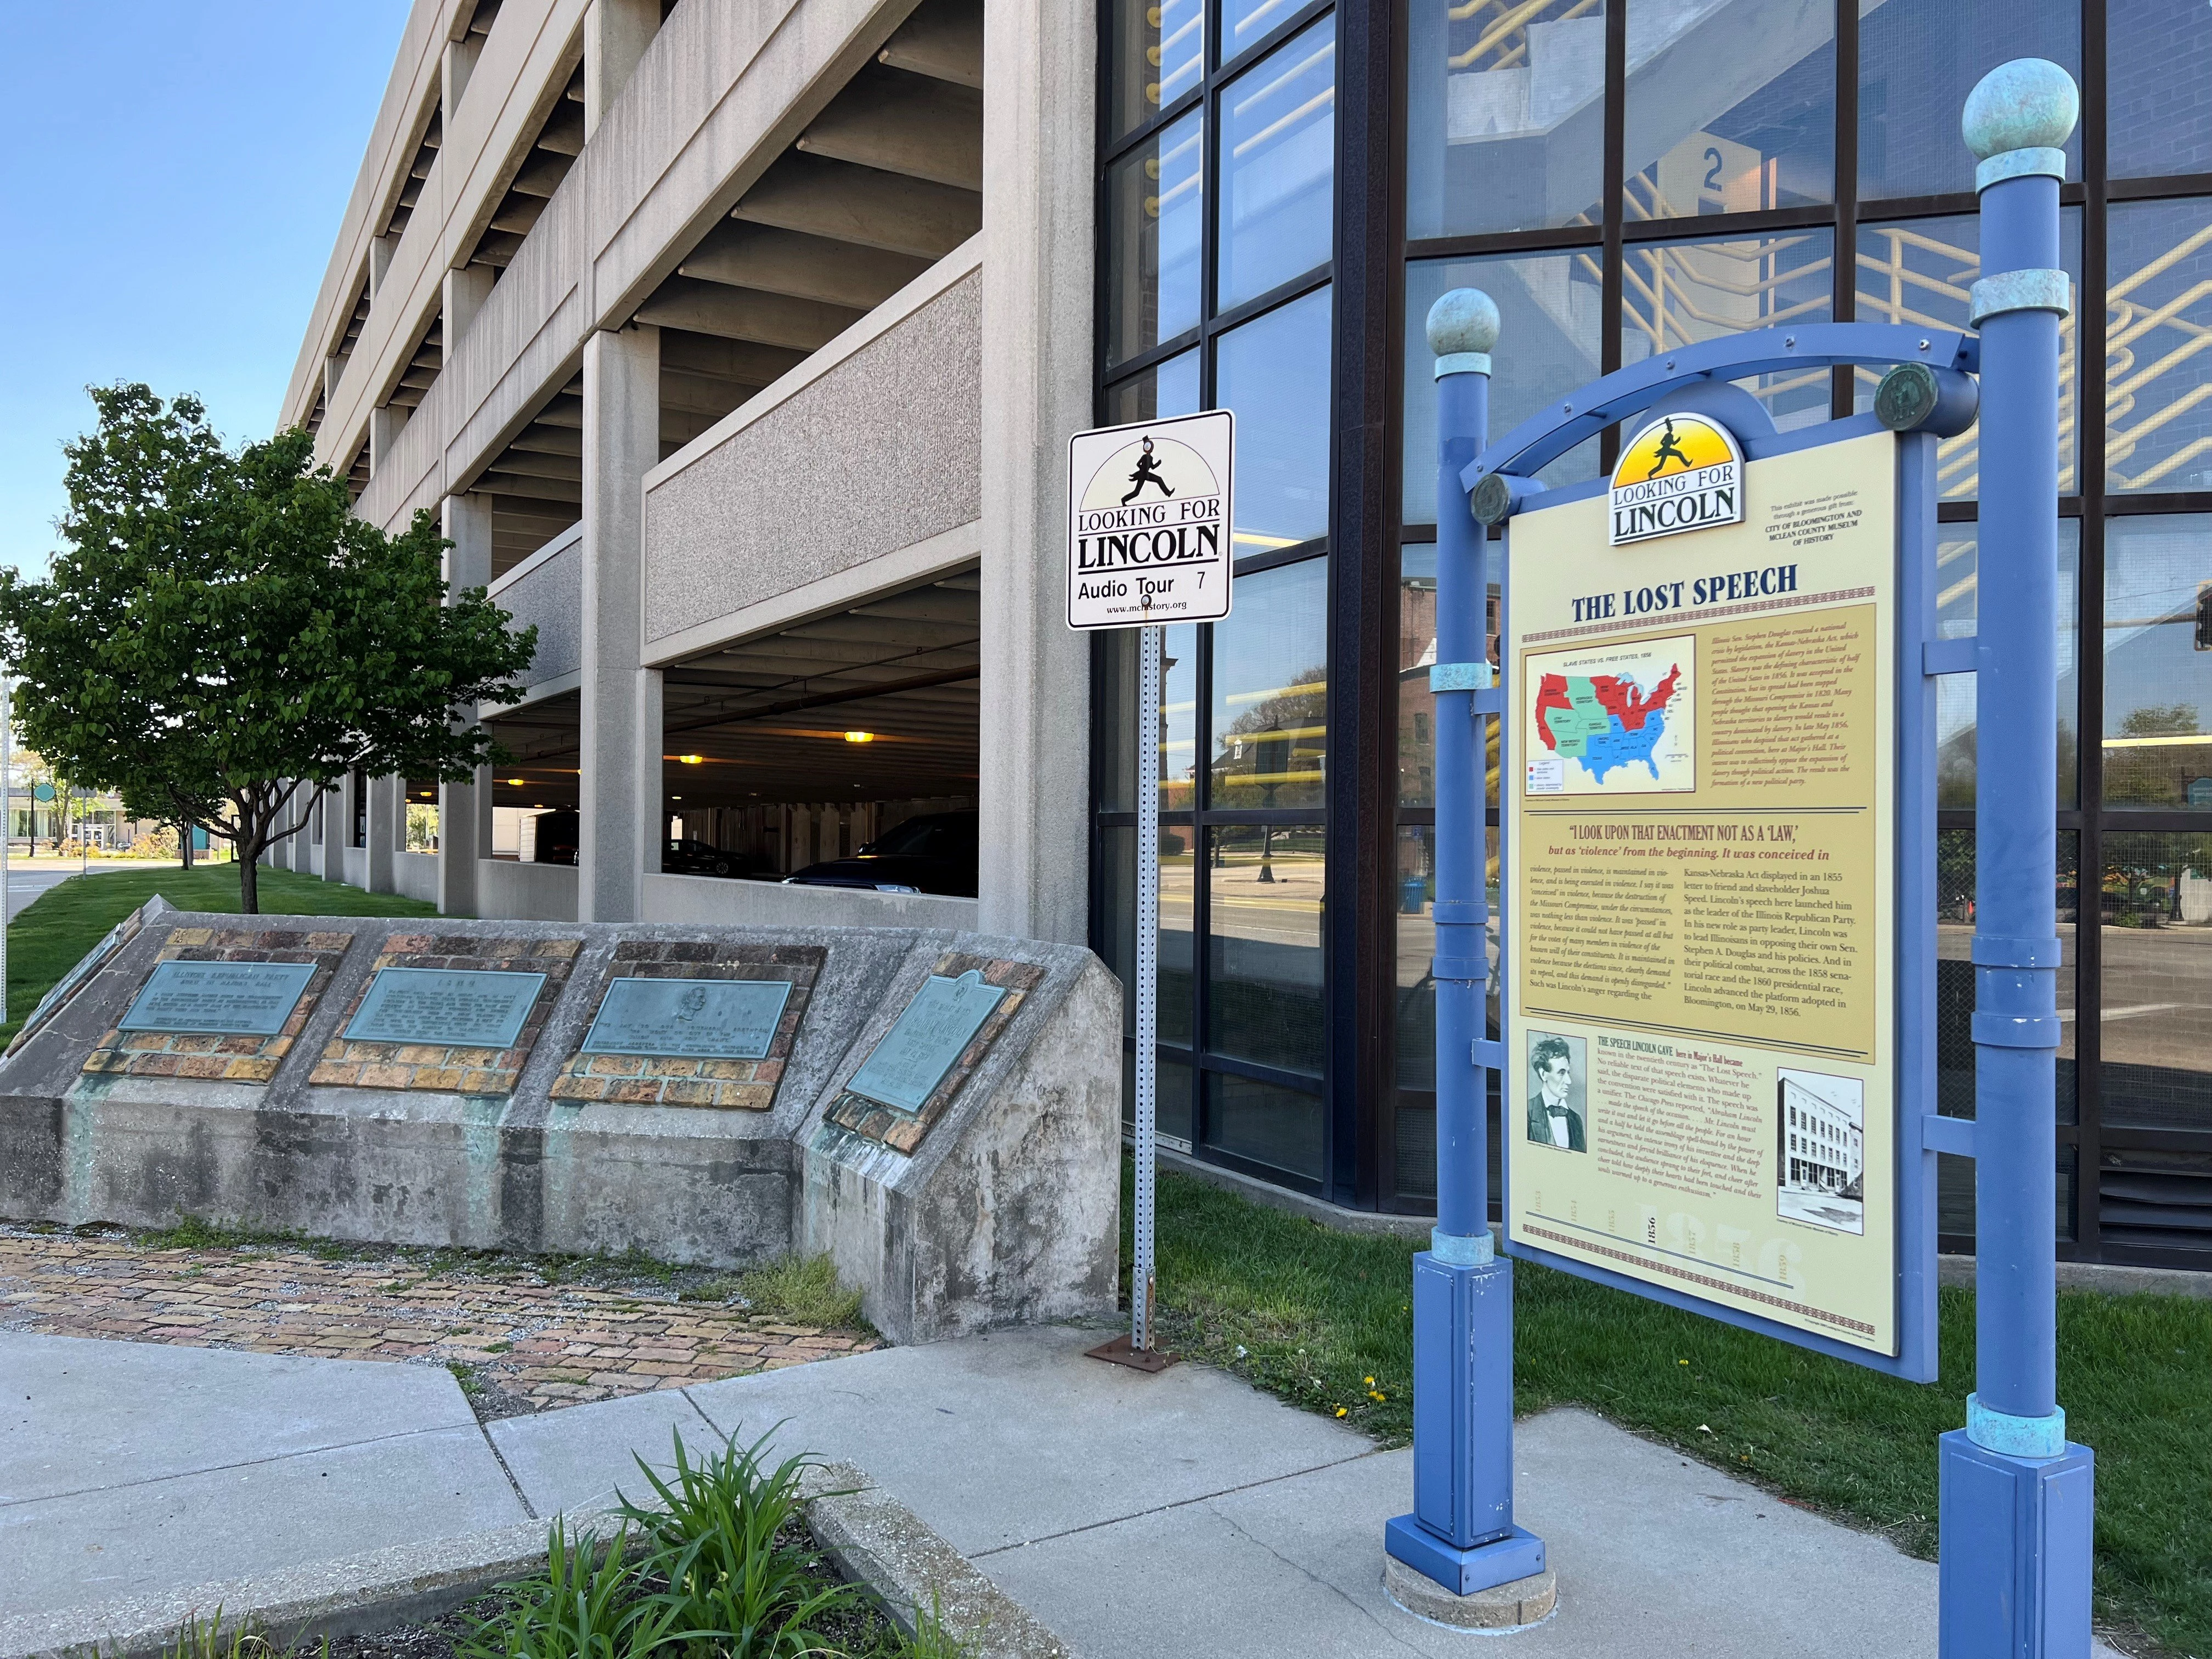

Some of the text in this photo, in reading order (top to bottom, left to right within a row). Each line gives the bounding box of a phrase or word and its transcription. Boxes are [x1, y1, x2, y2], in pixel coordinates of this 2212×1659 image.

[1704, 148, 1722, 191] 2
[1614, 465, 1734, 505] LOOKING FOR
[1079, 499, 1220, 532] LOOKING FOR
[1615, 487, 1735, 537] LINCOLN
[1078, 524, 1220, 568] LINCOLN
[1078, 571, 1205, 599] Audio Tour 7
[1571, 563, 1797, 622] THE LOST SPEECH
[1578, 825, 1602, 839] LOOK
[1605, 825, 1629, 839] UPON
[1631, 825, 1655, 840] THAT
[1657, 825, 1714, 840] ENACTMENT
[1717, 825, 1738, 840] NOT
[1740, 825, 1754, 841] AS
[1756, 825, 1764, 841] A
[1548, 845, 1563, 854] but
[1622, 846, 1645, 856] from
[1648, 847, 1664, 856] the
[1666, 847, 1719, 860] beginning.
[1722, 848, 1730, 858] It
[1758, 849, 1815, 860] conceived
[1818, 849, 1829, 860] in
[1684, 868, 1744, 878] Kansas-Nebraska
[1745, 870, 1759, 878] Act
[1760, 870, 1797, 882] displayed
[1799, 872, 1808, 880] in
[1823, 872, 1842, 881] 1855
[1684, 881, 1703, 889] letter
[1714, 882, 1737, 890] friend
[1739, 883, 1753, 891] and
[1755, 884, 1800, 893] slaveholder
[1800, 885, 1829, 896] Joshua
[1684, 894, 1852, 910] Speed. Lincoln's speech here launched him
[1684, 919, 1692, 927] In
[1694, 919, 1705, 928] his
[1722, 922, 1737, 930] role
[1748, 926, 1768, 935] party
[1770, 924, 1797, 935] leader,
[1798, 926, 1831, 936] Lincoln
[1692, 907, 1705, 915] the
[1706, 907, 1730, 917] leader
[1731, 909, 1740, 917] of
[1741, 909, 1753, 918] the
[1756, 910, 1782, 920] Illinois
[1784, 912, 1830, 924] Republican
[1832, 914, 1855, 927] Party.
[1692, 932, 1708, 941] lead
[1710, 933, 1748, 944] Illinoisans
[1750, 936, 1758, 945] in
[1759, 939, 1796, 951] opposing
[1798, 940, 1818, 950] their
[1839, 943, 1858, 952] Sen.
[1683, 944, 1852, 966] Stephen A. Douglas and his policies. And in
[1684, 957, 1701, 966] their
[1702, 960, 1733, 969] political
[1734, 963, 1765, 973] combat,
[1792, 967, 1806, 976] the
[1809, 968, 1828, 978] 1858
[1684, 971, 1703, 979] torial
[1722, 974, 1736, 983] and
[1738, 975, 1751, 984] the
[1753, 977, 1771, 986] 1860
[1773, 980, 1820, 991] presidential
[1822, 985, 1843, 995] race,
[1684, 983, 1846, 1008] Lincoln advanced the platform adopted in
[1684, 995, 1734, 1009] Bloomington,
[1747, 1002, 1764, 1014] May
[1765, 1004, 1778, 1015] 29,
[1780, 1006, 1801, 1017] 1856.
[939, 1022, 967, 1037] LINCOLN
[1597, 1035, 1742, 1067] THE SPEECH LINCOLN GAVE here in Major's Hall became
